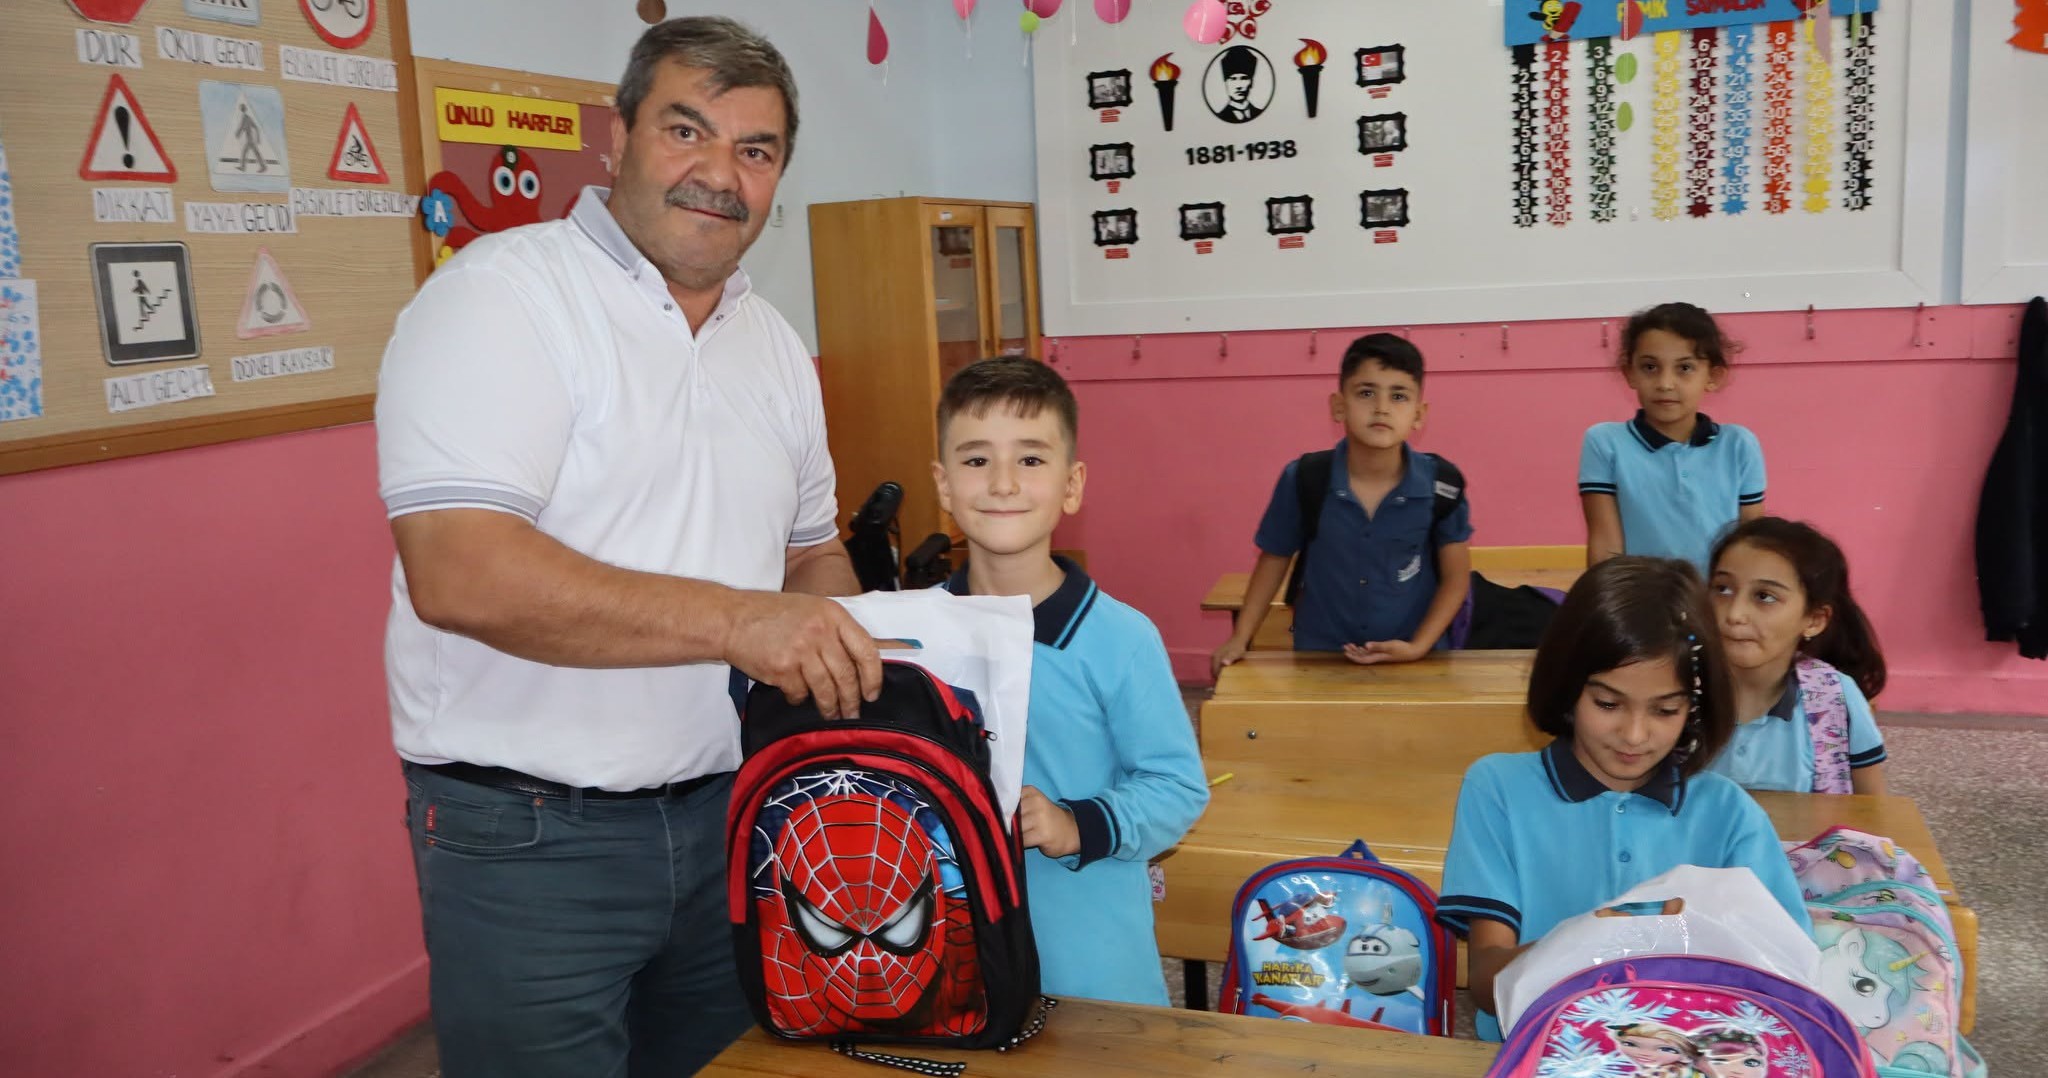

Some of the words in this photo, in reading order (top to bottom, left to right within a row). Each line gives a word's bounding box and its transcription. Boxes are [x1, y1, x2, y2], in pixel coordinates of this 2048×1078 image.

[1736, 35, 1746, 47] 7
[1776, 32, 1786, 45] 8
[84, 31, 136, 64] DUR
[1663, 42, 1673, 52] 5
[1698, 39, 1710, 51] 6
[1551, 51, 1561, 62] 2
[1593, 47, 1604, 58] 3
[1772, 52, 1787, 63] 16
[1852, 47, 1870, 59] 20
[1696, 58, 1711, 70] 12
[1736, 56, 1746, 66] 4
[1520, 73, 1529, 84] 2
[1550, 71, 1561, 82] 4
[1594, 67, 1606, 79] 6
[1770, 72, 1786, 84] 24
[1850, 67, 1869, 79] 30
[1699, 77, 1710, 89] 8
[1729, 74, 1744, 85] 21
[1519, 91, 1529, 102] 3
[1550, 88, 1561, 99] 6
[1596, 85, 1607, 96] 9
[1849, 85, 1868, 97] 40
[1693, 95, 1710, 107] 24
[1728, 91, 1746, 103] 28
[1551, 106, 1561, 117] 8
[1594, 102, 1610, 113] 12
[1850, 104, 1868, 117] 50
[1519, 109, 1530, 121] 4
[1692, 113, 1710, 125] 30
[1728, 110, 1745, 122] 35
[507, 110, 574, 136] HARFLER
[1549, 123, 1563, 134] 10
[1594, 120, 1610, 132] 15
[1851, 121, 1868, 134] 60
[1521, 127, 1531, 138] 5
[1692, 131, 1710, 143] 36
[1726, 127, 1745, 139] 42
[1765, 125, 1785, 137] 48
[1520, 144, 1531, 155] 6
[1549, 141, 1564, 151] 12
[1595, 138, 1610, 149] 18
[1852, 141, 1868, 153] 70
[1186, 140, 1297, 166] 1881-1938
[1688, 149, 1709, 161] 42
[1726, 146, 1744, 158] 49
[1767, 145, 1786, 158] 56
[1550, 158, 1564, 169] 14
[1594, 156, 1609, 167] 21
[1850, 160, 1860, 173] 8
[1520, 163, 1531, 174] 7
[1689, 168, 1709, 180] 48
[1734, 164, 1744, 176] 6
[1767, 164, 1786, 176] 64
[1550, 177, 1565, 188] 16
[1594, 174, 1611, 185] 24
[1848, 179, 1859, 191] 9
[1520, 181, 1530, 192] 8
[1690, 186, 1709, 198] 54
[1726, 183, 1743, 195] 63
[1776, 181, 1786, 193] 2
[1520, 198, 1530, 209] 9
[1848, 196, 1863, 209] 10
[190, 203, 238, 231] YAYA
[434, 201, 448, 223] A
[1550, 212, 1566, 223] 20
[110, 377, 147, 408] ALT
